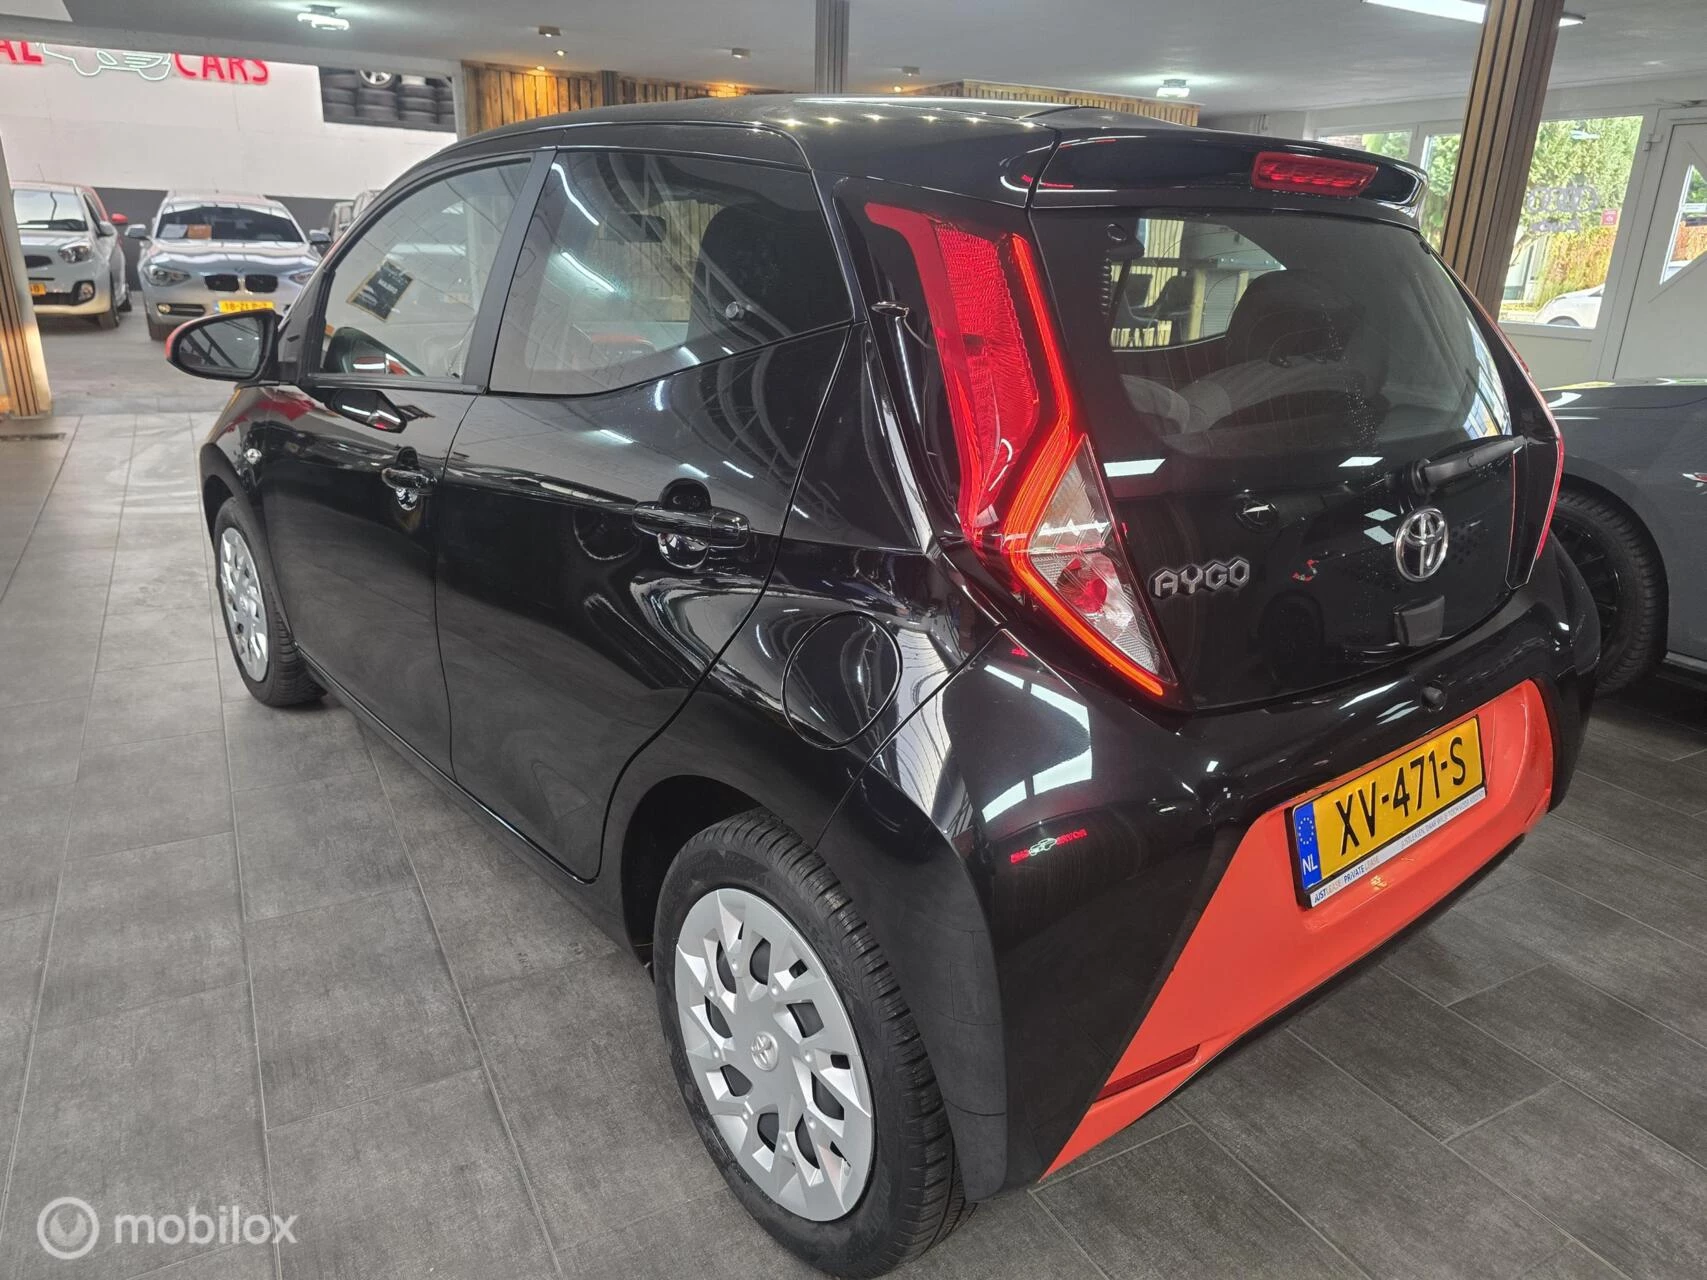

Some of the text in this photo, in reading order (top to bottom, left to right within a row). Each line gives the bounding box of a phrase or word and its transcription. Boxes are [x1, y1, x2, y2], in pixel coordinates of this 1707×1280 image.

[173, 52, 269, 83] CARS
[1152, 557, 1250, 597] AYGO
[1335, 737, 1466, 855] XV-471-S
[1302, 854, 1318, 875] NL
